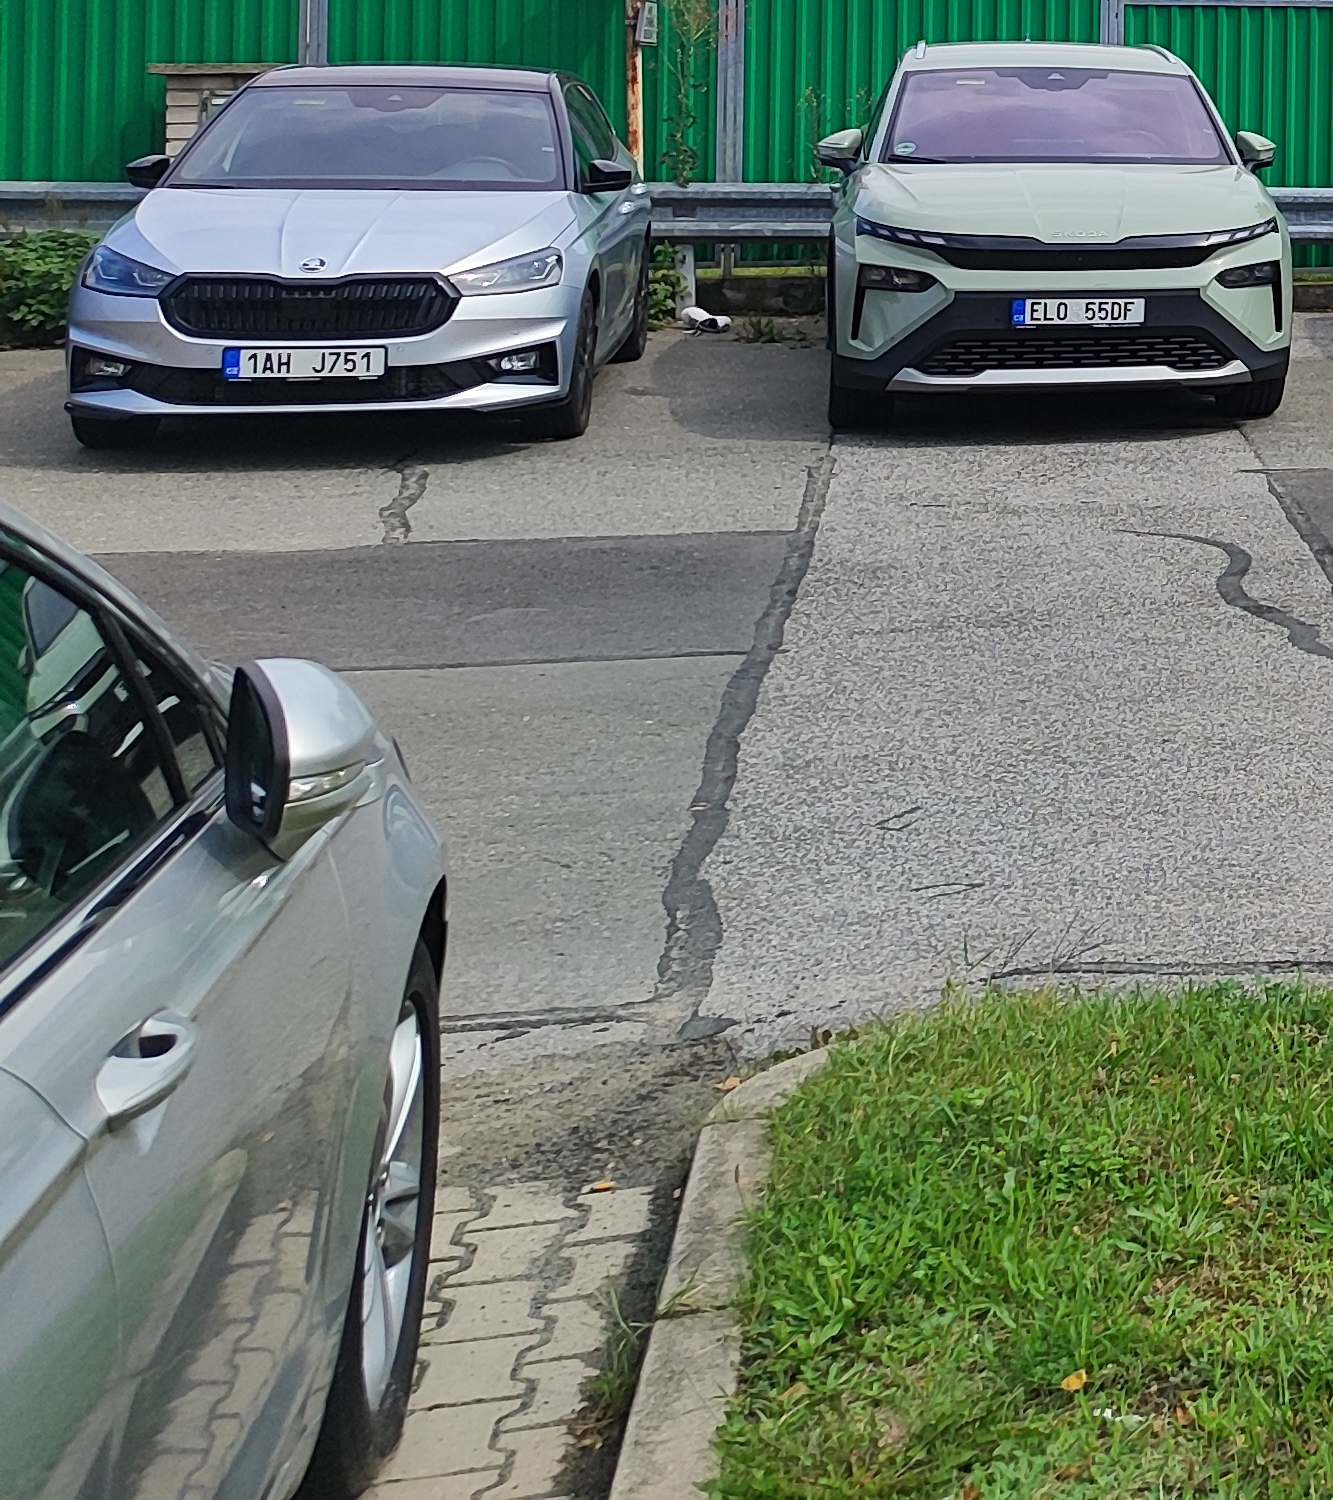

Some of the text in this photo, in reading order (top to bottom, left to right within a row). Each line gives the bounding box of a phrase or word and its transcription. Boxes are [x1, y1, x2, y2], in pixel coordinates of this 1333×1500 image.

[1084, 301, 1135, 321] 55DF
[247, 351, 372, 375] 1AH J751
